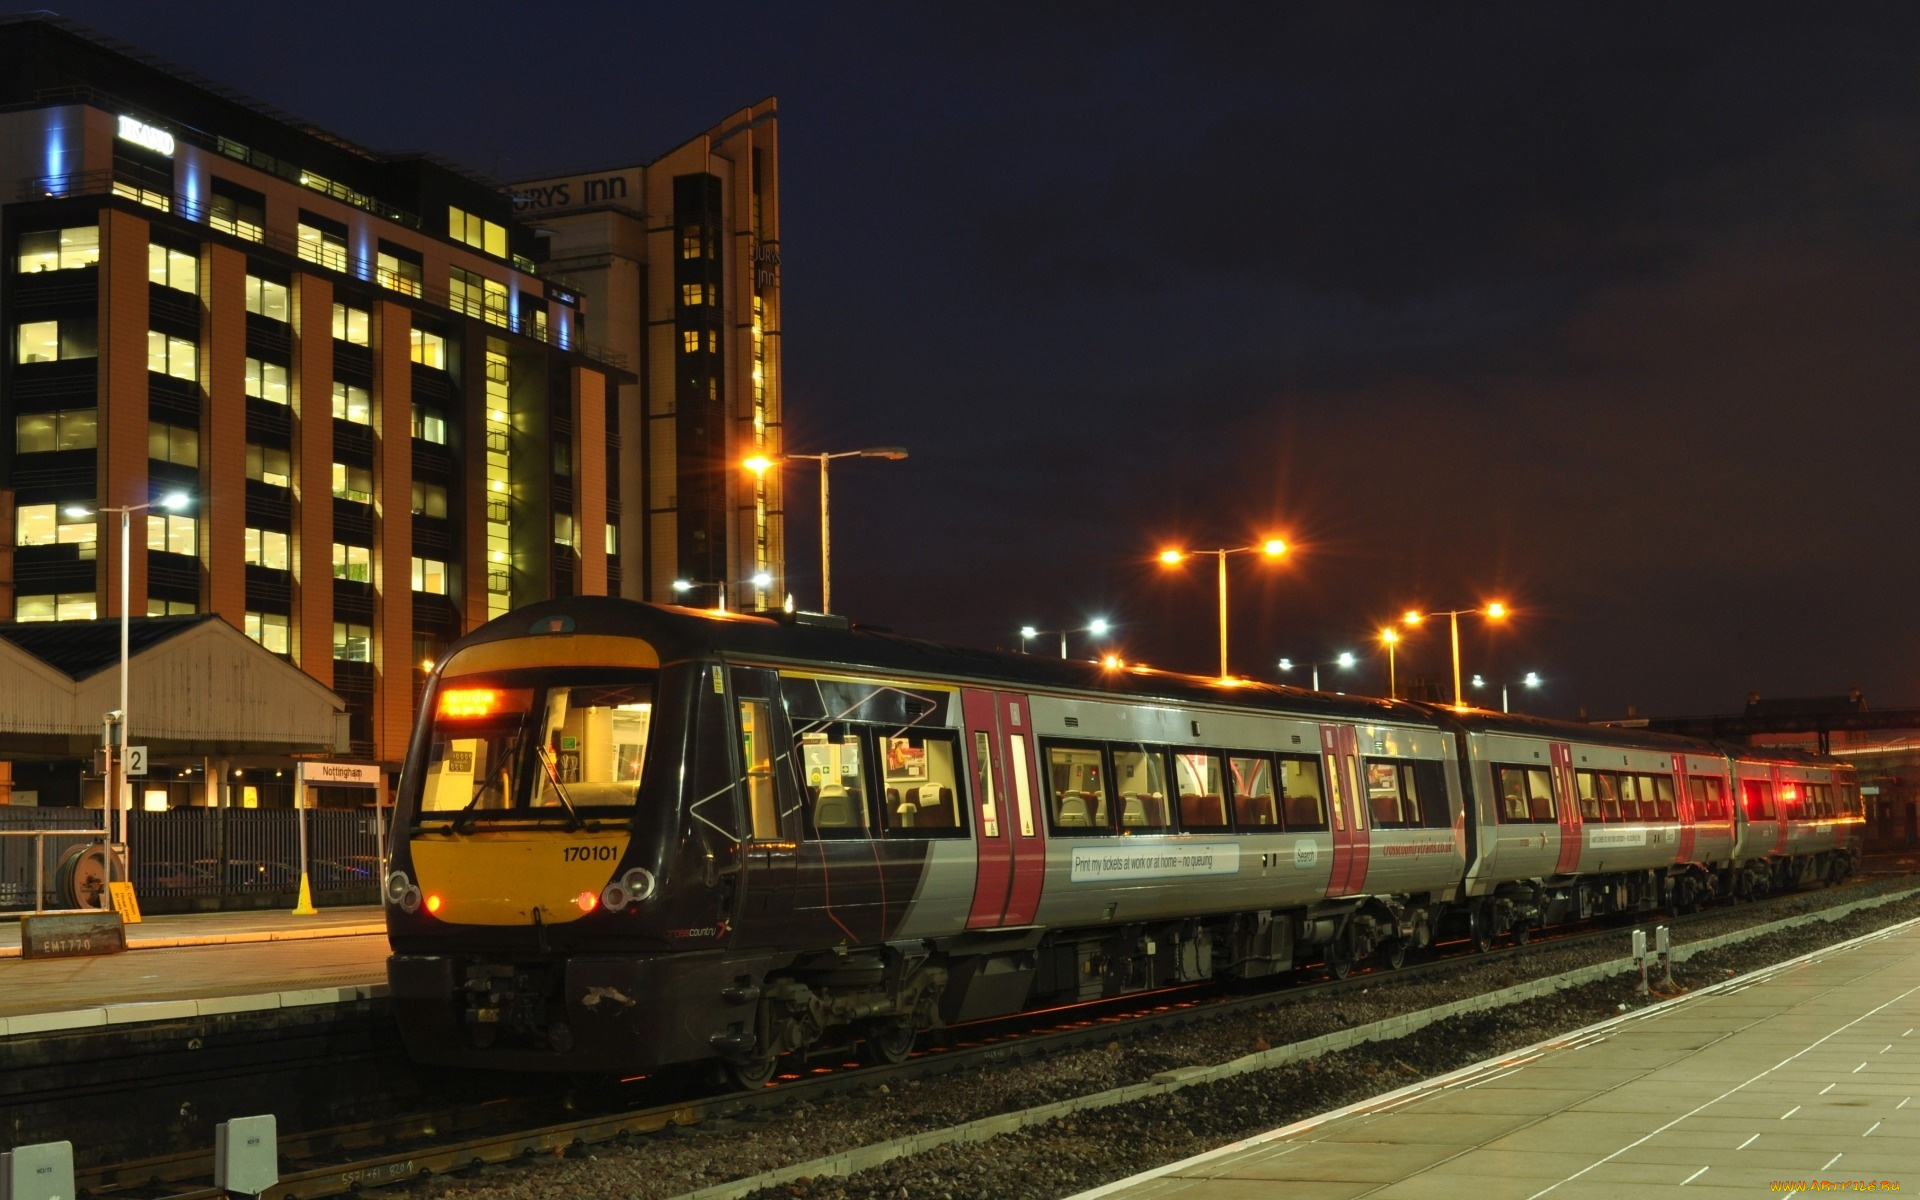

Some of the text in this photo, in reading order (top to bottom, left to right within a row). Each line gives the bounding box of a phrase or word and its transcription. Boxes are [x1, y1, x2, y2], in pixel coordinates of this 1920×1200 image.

[512, 183, 570, 211] URYS
[131, 750, 141, 770] 2
[322, 766, 363, 779] Nottingham
[563, 846, 618, 862] 170101
[1297, 848, 1315, 863] Search
[1075, 856, 1090, 872] Print
[1092, 859, 1102, 875] my
[1103, 855, 1122, 871] tickets
[1124, 855, 1130, 870] at
[1131, 854, 1146, 870] work
[1146, 857, 1153, 869] or
[1154, 855, 1160, 869] at
[1161, 854, 1176, 868] home
[1183, 856, 1190, 867] no
[1191, 855, 1213, 870] queuing
[43, 939, 92, 953] EMT770
